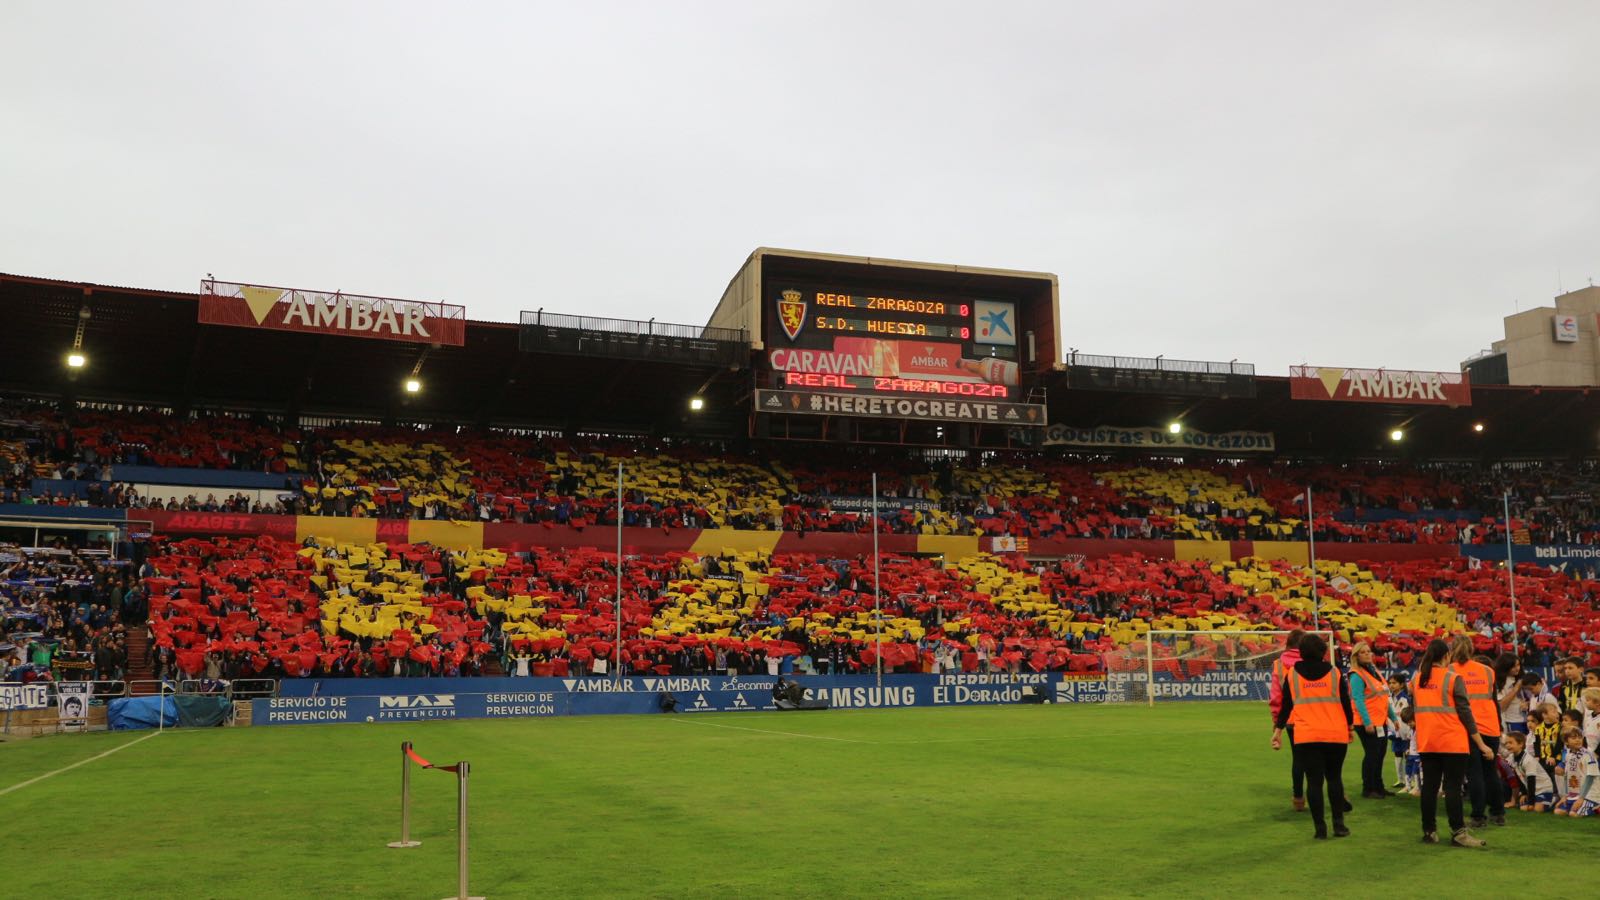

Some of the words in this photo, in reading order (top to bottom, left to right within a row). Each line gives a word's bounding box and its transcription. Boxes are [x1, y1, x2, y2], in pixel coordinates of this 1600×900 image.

[816, 293, 855, 307] REAL
[867, 297, 944, 314] ZARAGOZA
[960, 305, 969, 316] 0
[282, 294, 431, 337] AMBAR
[816, 317, 854, 331] S.D.
[867, 322, 926, 336] HUESCA
[960, 328, 969, 339] 0
[911, 356, 948, 367] AMBAR
[786, 372, 857, 388] REAL
[874, 377, 1008, 397] ZARAGOZA
[1347, 374, 1447, 400] AMBAR
[810, 394, 999, 420] #HERETOCREATE
[1535, 546, 1557, 558] bcb
[577, 680, 634, 692] AMBAR
[657, 679, 711, 691] AMBAR
[1078, 681, 1125, 692] REALE
[269, 697, 326, 708] SERVICIO
[331, 697, 347, 706] DE
[486, 693, 536, 703] SERVICIO
[540, 693, 553, 702] DE
[802, 686, 915, 707] SAMSUNG
[1078, 693, 1126, 702] SEGUROS
[269, 709, 347, 721] PREVENCIÓN
[380, 709, 456, 719] PREVENCIÓN
[486, 704, 554, 715] PREVENCIÓN
